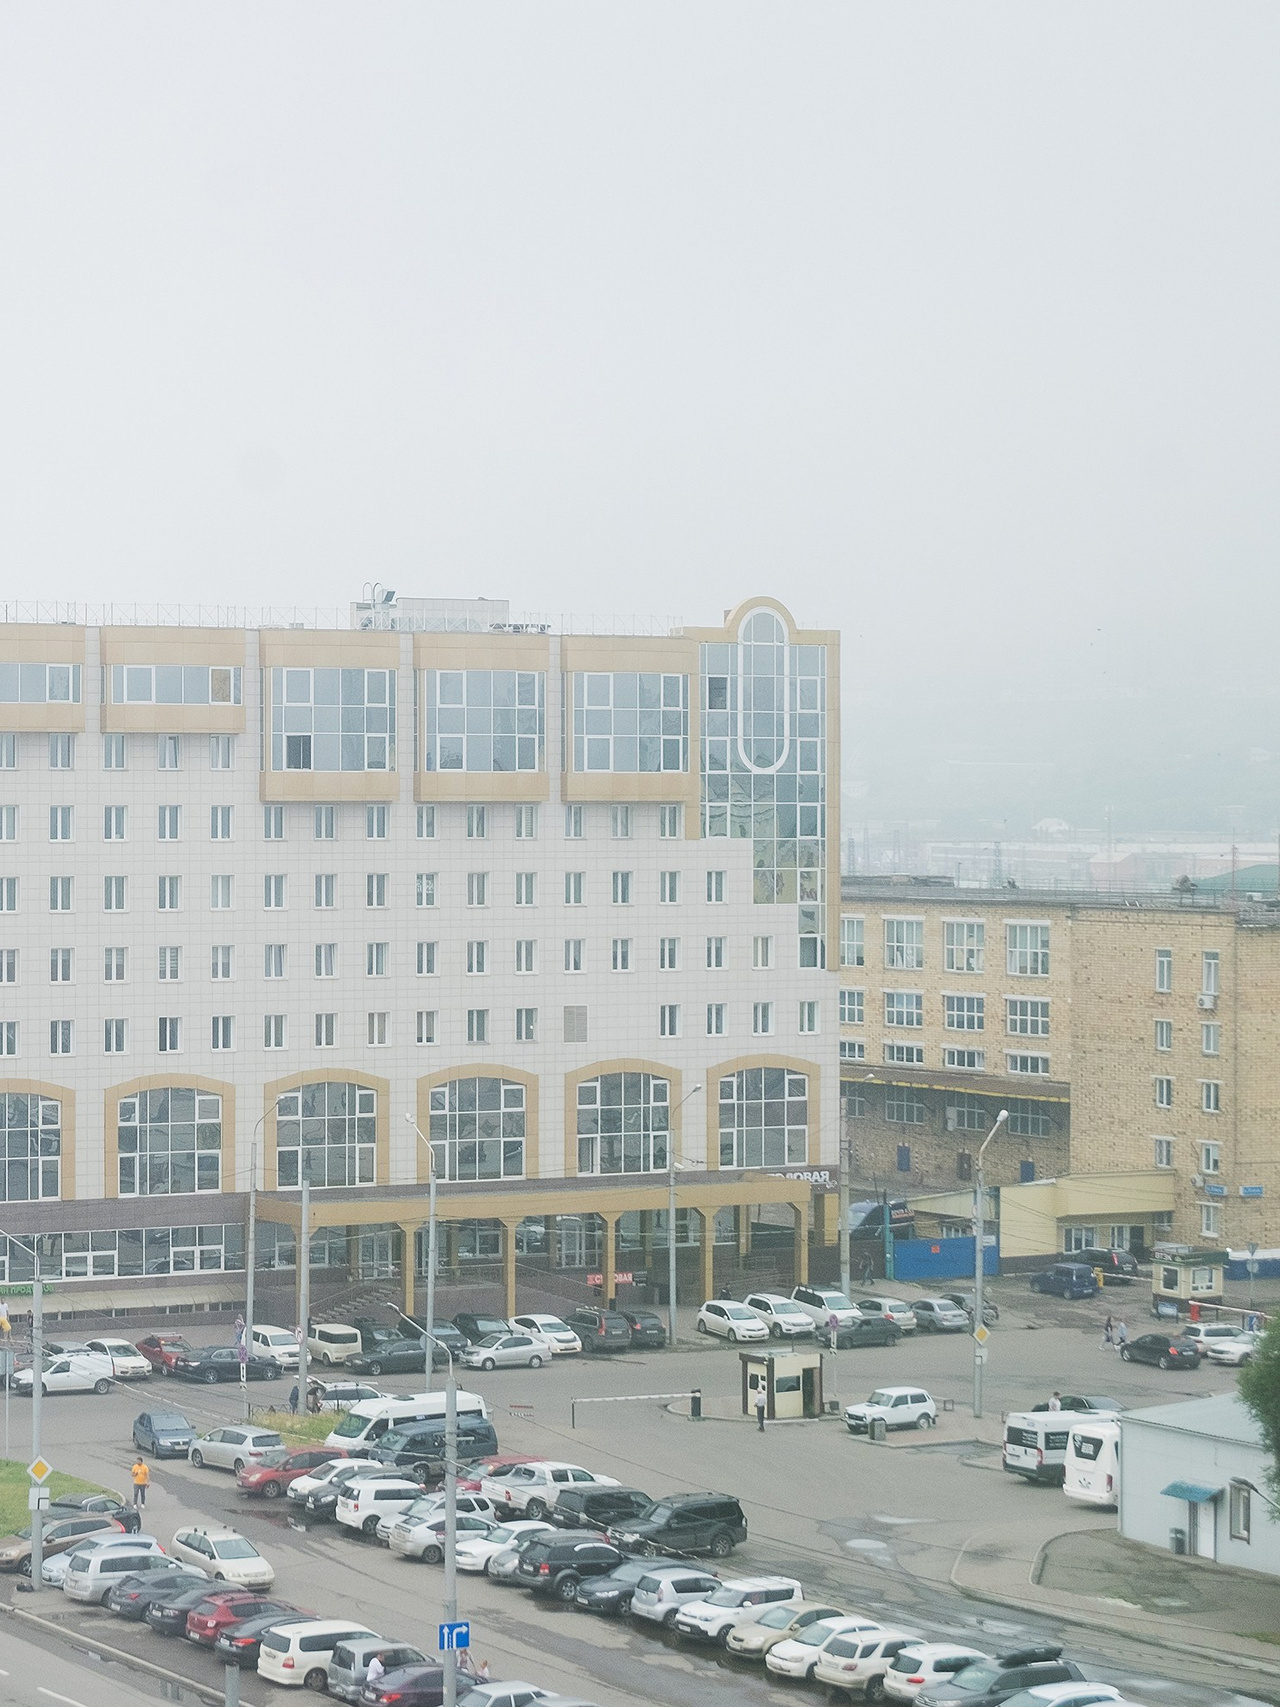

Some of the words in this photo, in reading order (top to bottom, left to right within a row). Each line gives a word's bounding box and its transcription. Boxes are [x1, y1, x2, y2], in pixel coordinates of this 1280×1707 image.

[767, 1171, 829, 1182] ЛОВАЯ
[594, 1273, 633, 1283] СОВАЯ
[10, 1284, 54, 1294] ПРОДОВ
